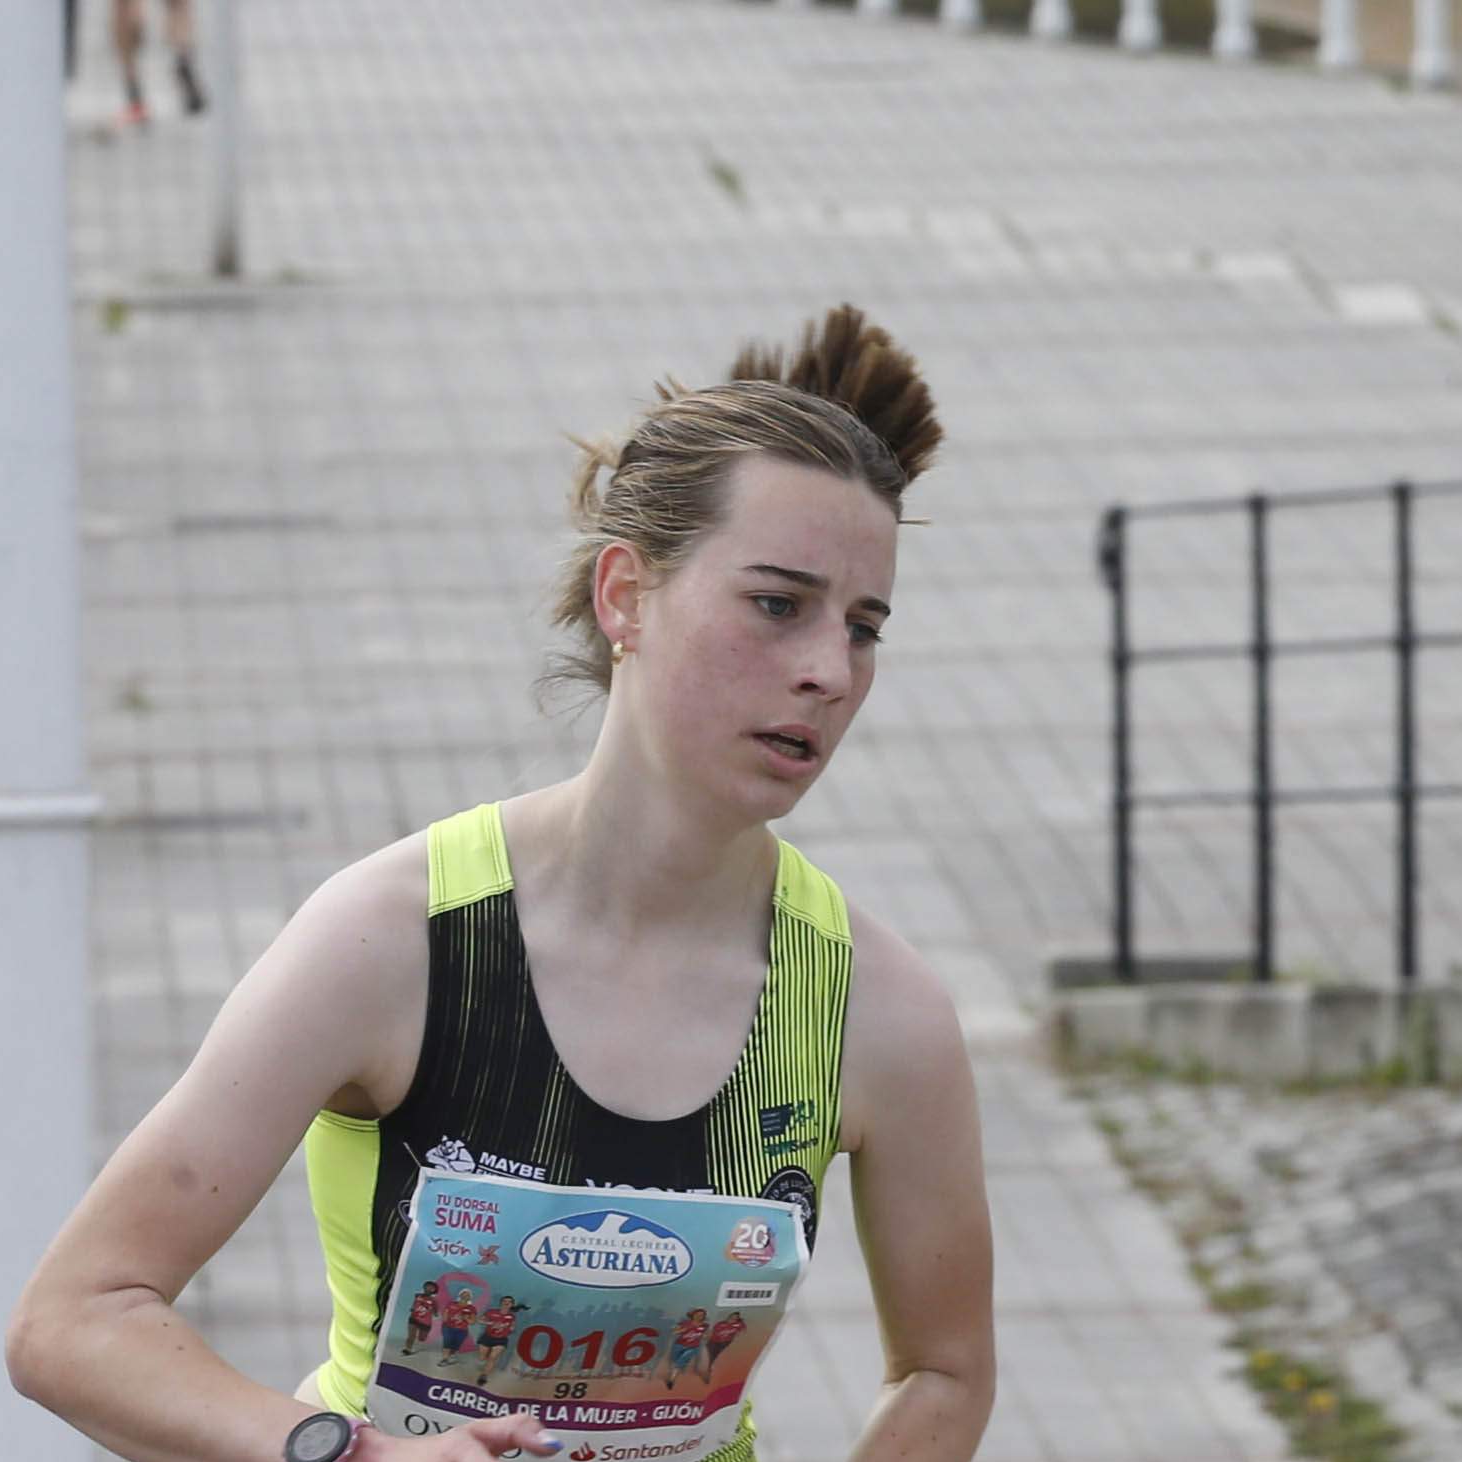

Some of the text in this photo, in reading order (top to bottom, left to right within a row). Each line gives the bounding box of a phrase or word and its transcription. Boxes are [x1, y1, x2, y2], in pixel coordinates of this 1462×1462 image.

[479, 1151, 547, 1181] MAYBE
[437, 1194, 500, 1214] TU DORSAL
[434, 1207, 496, 1234] SUMA
[530, 1235, 679, 1275] ASTURIANA
[560, 1235, 677, 1251] CENTRAL LECHERA
[516, 1324, 661, 1370] 016
[428, 1385, 510, 1418] CARRERA
[516, 1403, 541, 1420] DE
[545, 1405, 568, 1422] LA
[574, 1406, 636, 1424] MUJER
[652, 1403, 704, 1420] GIJÓN
[554, 1381, 588, 1400] 98
[599, 1434, 705, 1462] Santander
